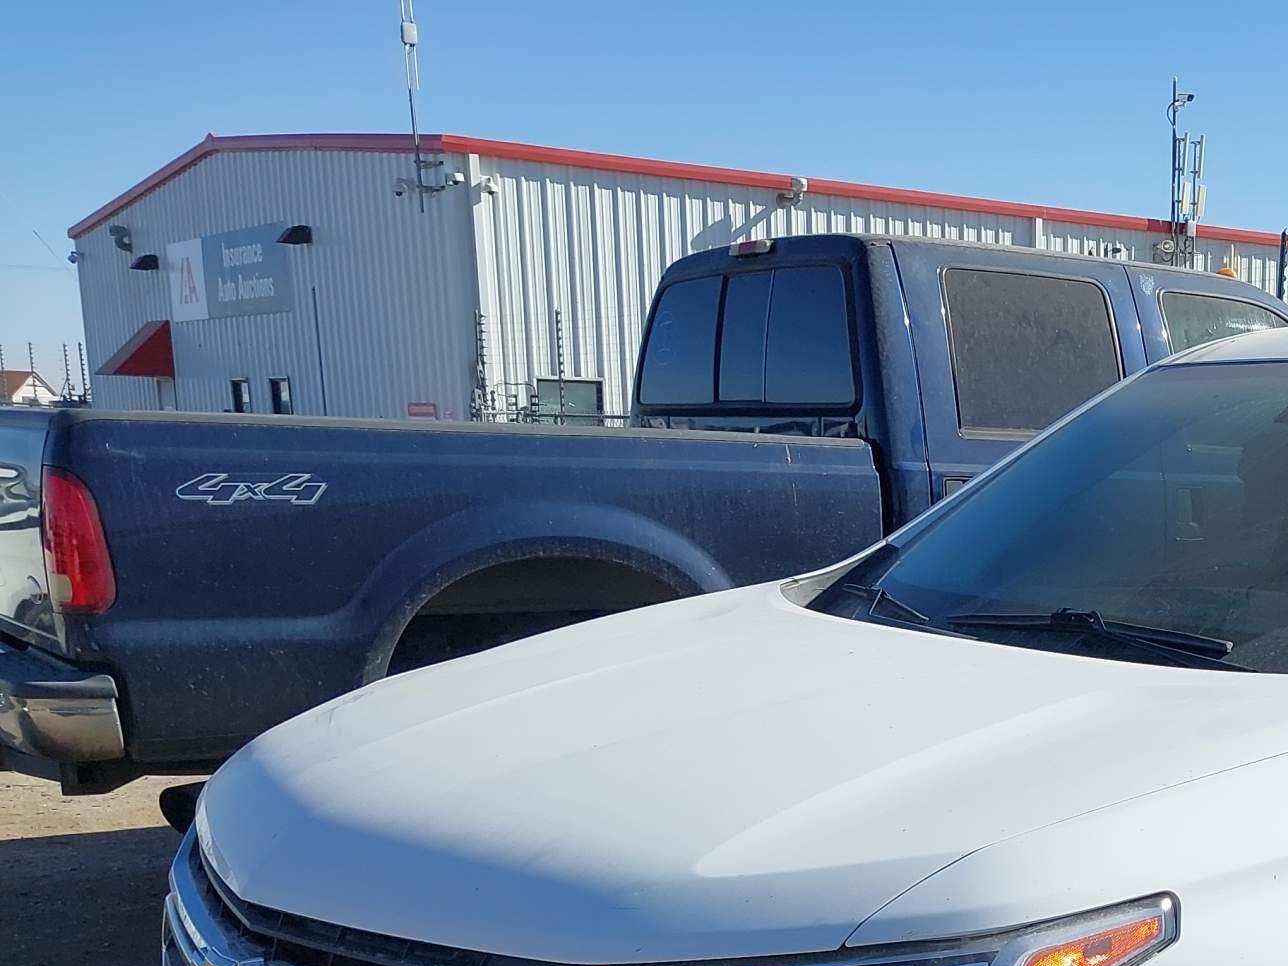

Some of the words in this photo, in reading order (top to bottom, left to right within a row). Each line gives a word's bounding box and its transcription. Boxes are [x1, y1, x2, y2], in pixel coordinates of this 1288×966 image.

[221, 240, 263, 268] Insurance
[218, 277, 237, 302] Auto
[238, 272, 275, 300] Auctions
[176, 473, 328, 505] 4x4
